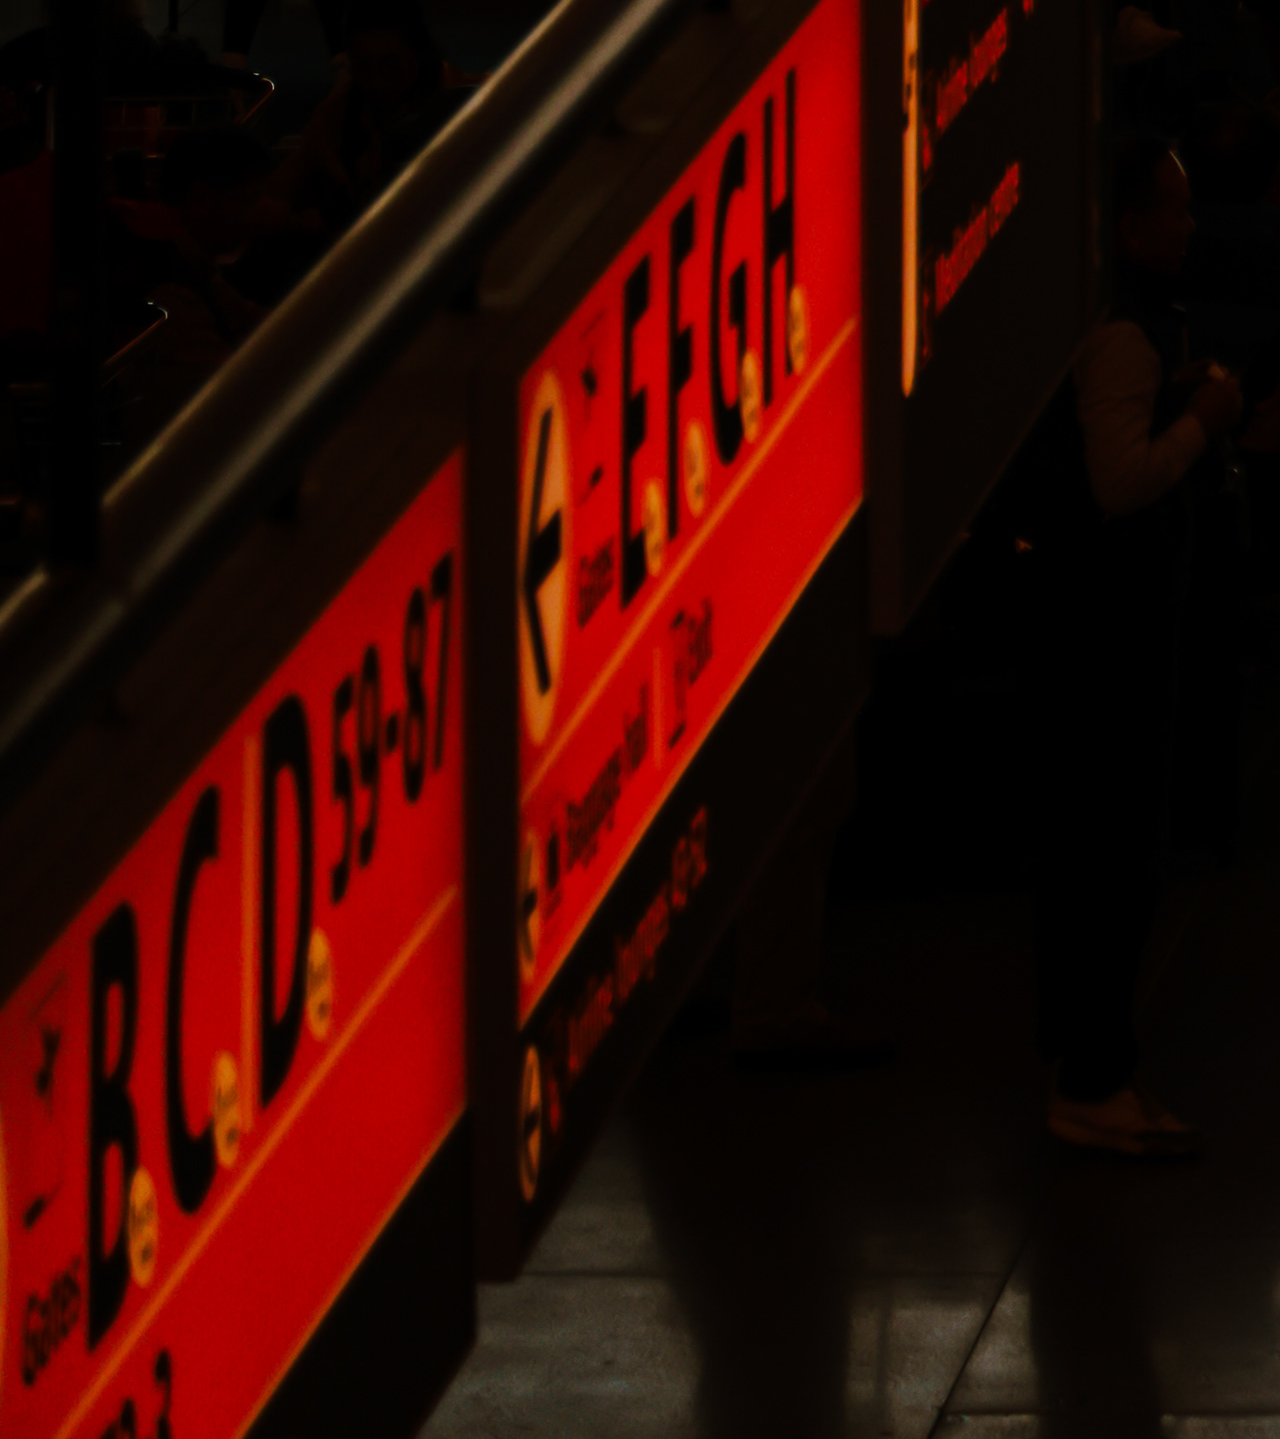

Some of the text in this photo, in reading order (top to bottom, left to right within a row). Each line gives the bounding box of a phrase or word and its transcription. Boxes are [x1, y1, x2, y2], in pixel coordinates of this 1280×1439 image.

[617, 256, 650, 612] E
[665, 192, 692, 542] F
[708, 132, 746, 466] G
[761, 69, 796, 410] H
[86, 906, 139, 1356] B
[166, 784, 219, 1218] C
[261, 694, 314, 1106] D
[329, 549, 456, 905] 59-87
